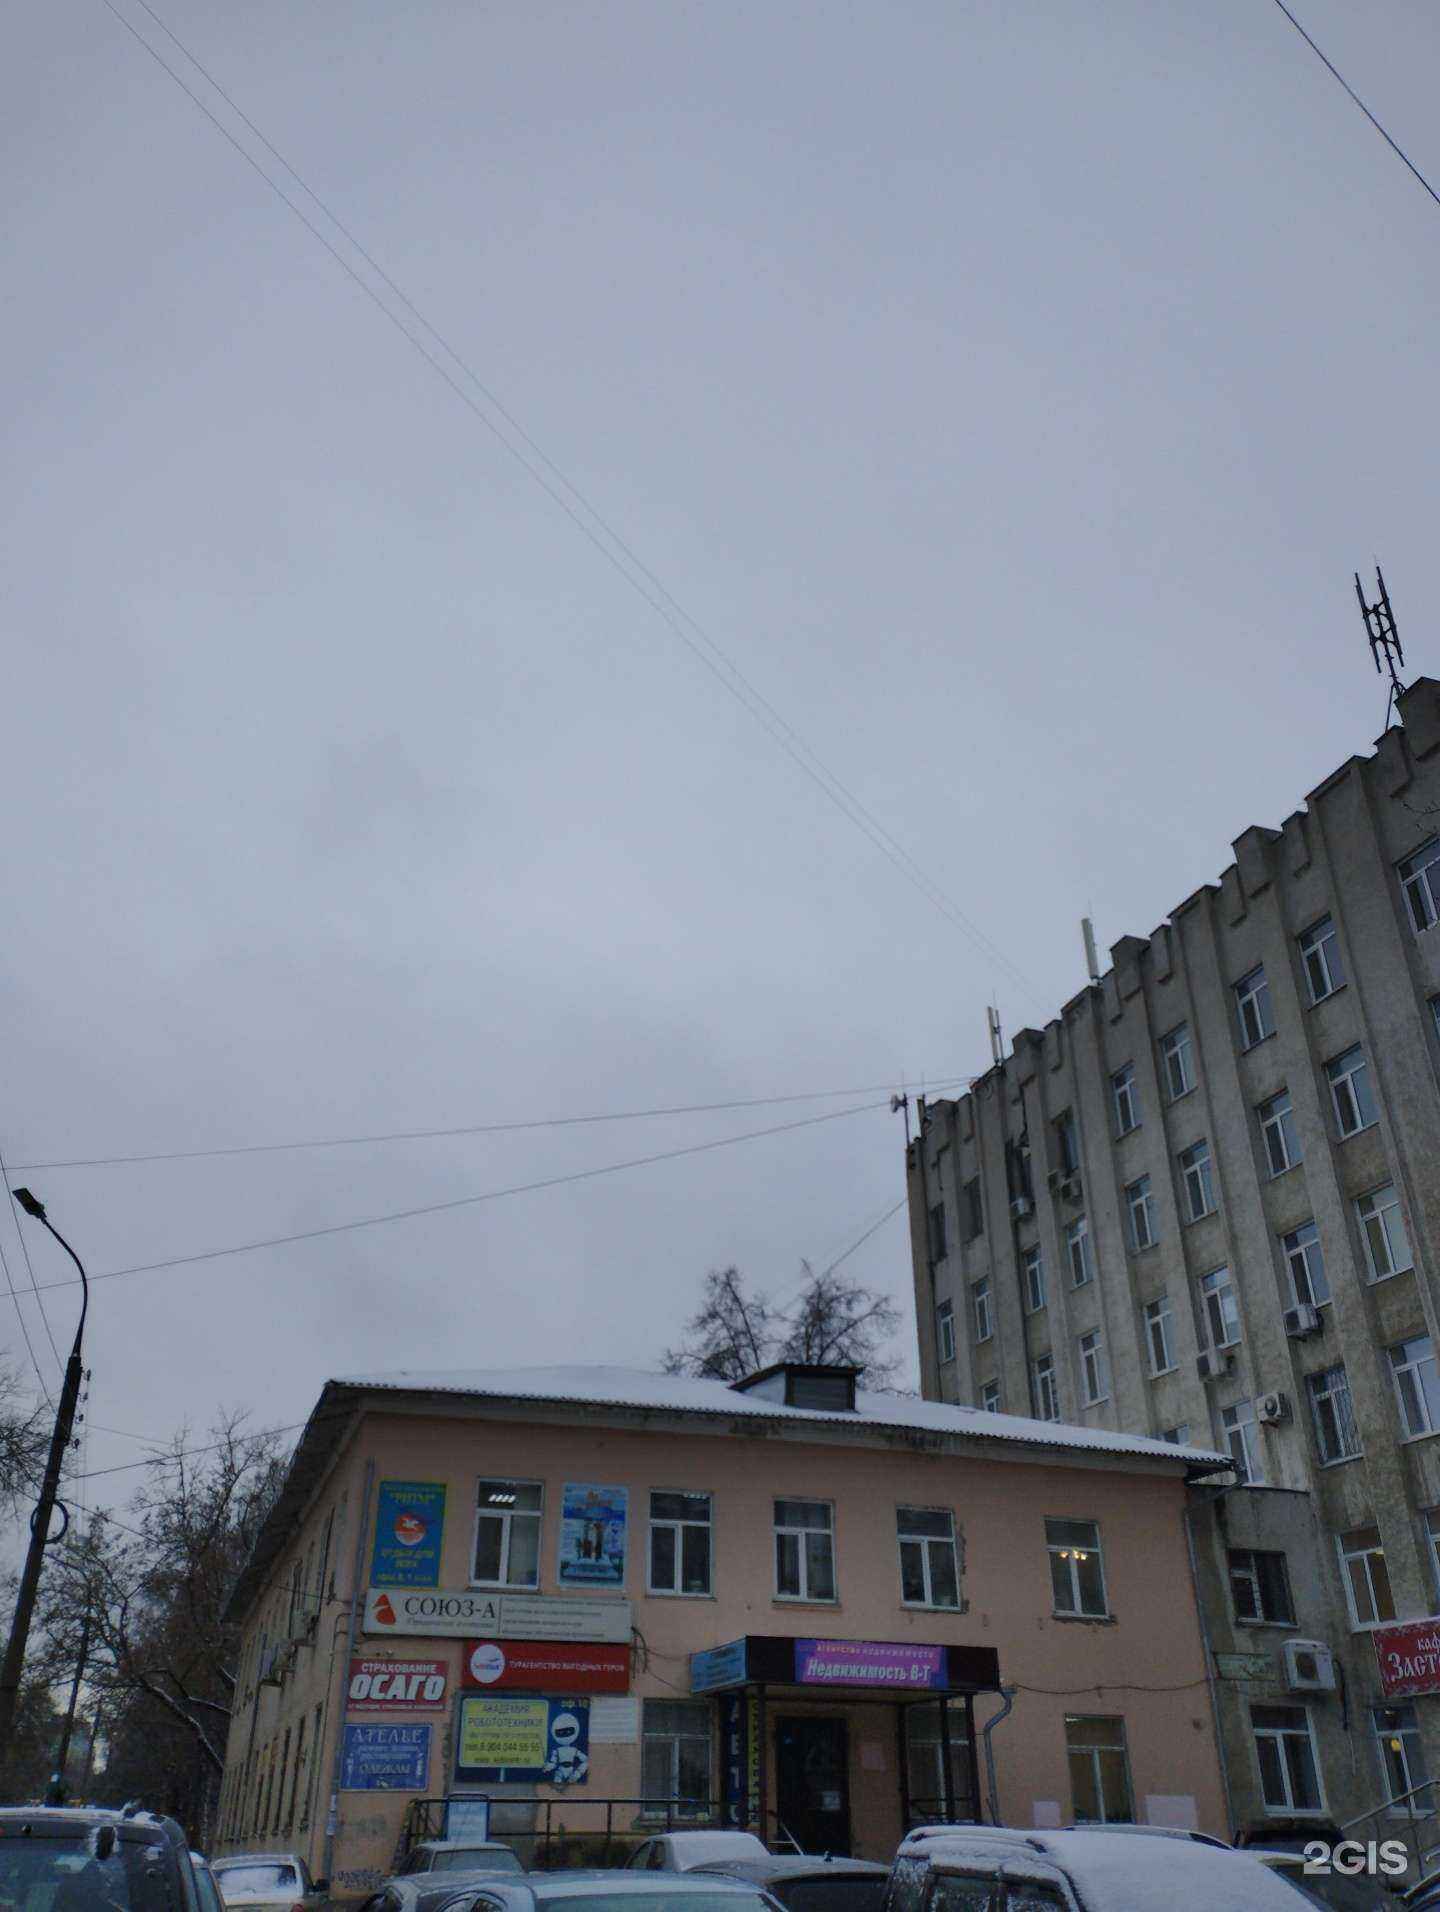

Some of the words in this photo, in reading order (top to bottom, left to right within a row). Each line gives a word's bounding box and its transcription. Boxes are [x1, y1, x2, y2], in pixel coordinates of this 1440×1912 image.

[404, 1596, 496, 1618] СОЮЗ-А
[361, 1663, 437, 1673] СТРАХОВАНИЕ
[349, 1674, 446, 1701] ОСАГО
[352, 1728, 423, 1744] АТЕЛЬЕ
